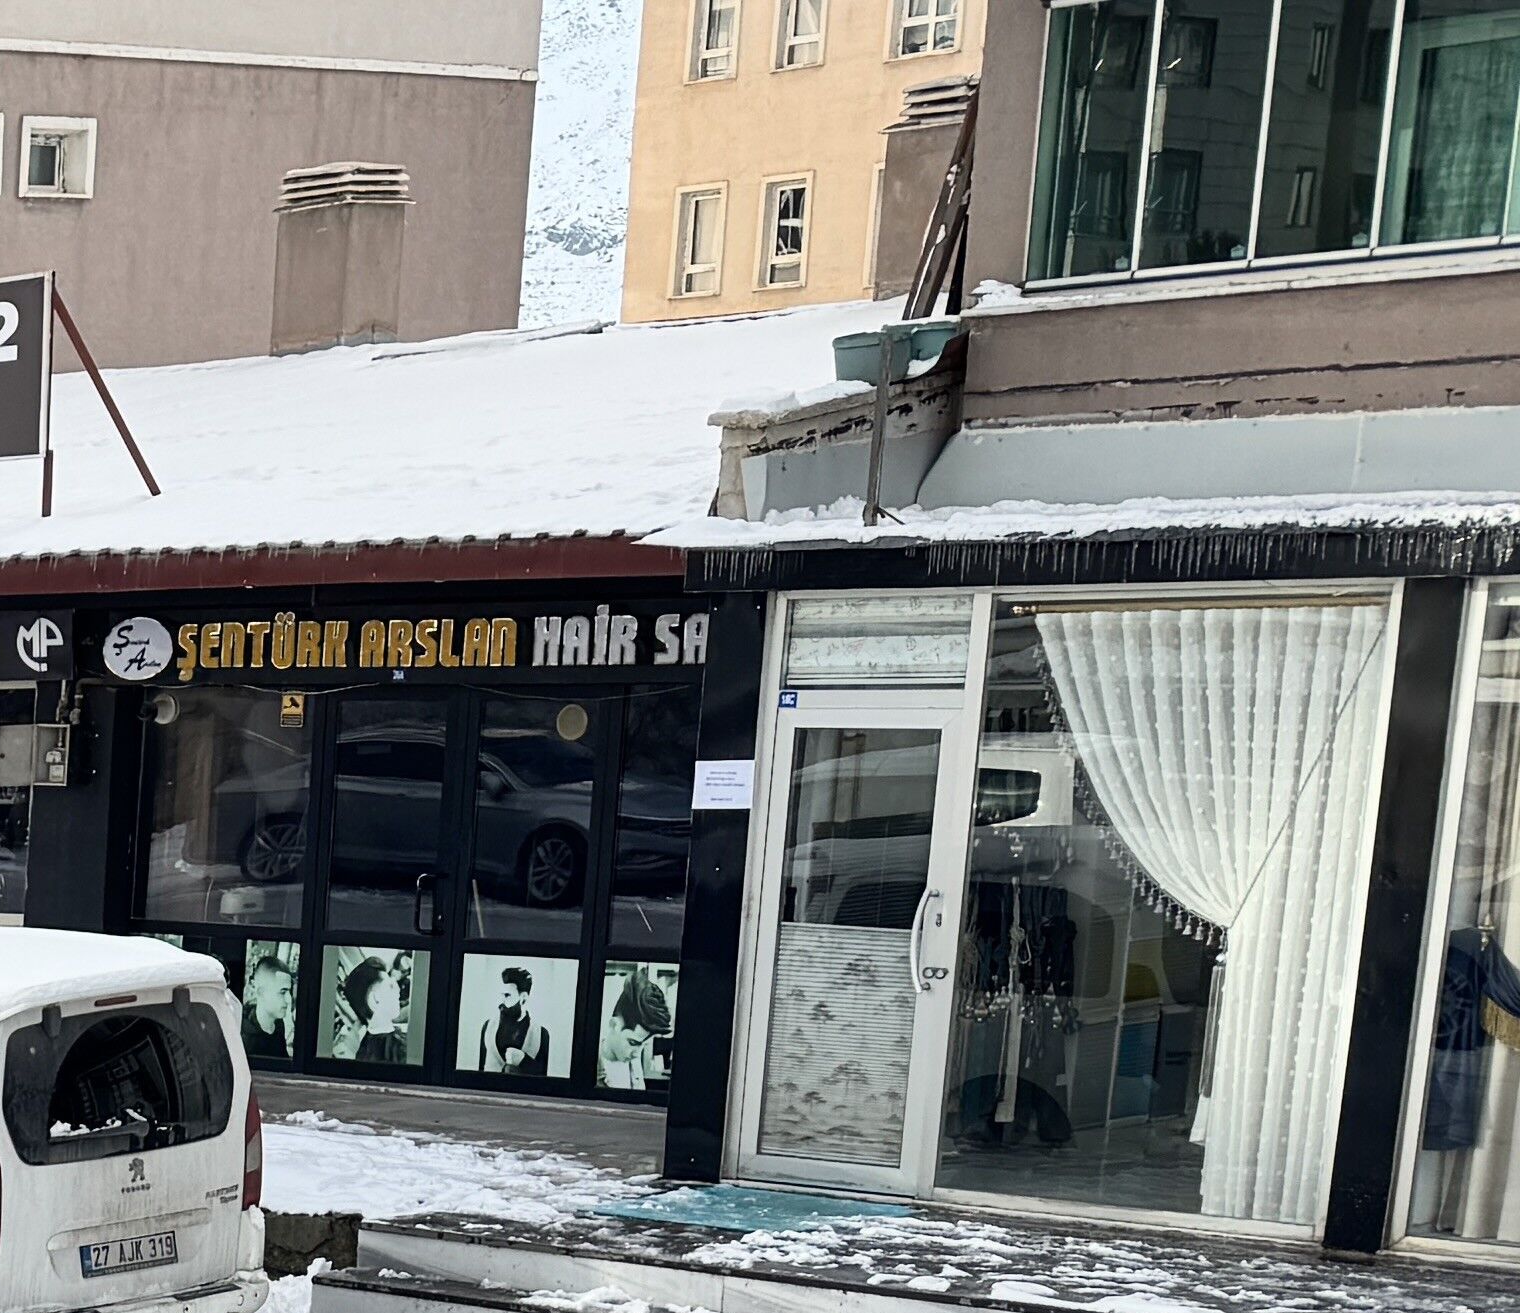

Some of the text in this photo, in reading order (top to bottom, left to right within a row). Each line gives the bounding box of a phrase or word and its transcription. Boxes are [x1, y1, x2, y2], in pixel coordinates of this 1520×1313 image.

[176, 611, 349, 681] ŞENTÜRK
[359, 617, 518, 668] ARSLAN
[92, 1245, 110, 1268] 27
[119, 1240, 144, 1264] AJK
[148, 1235, 174, 1258] 319
